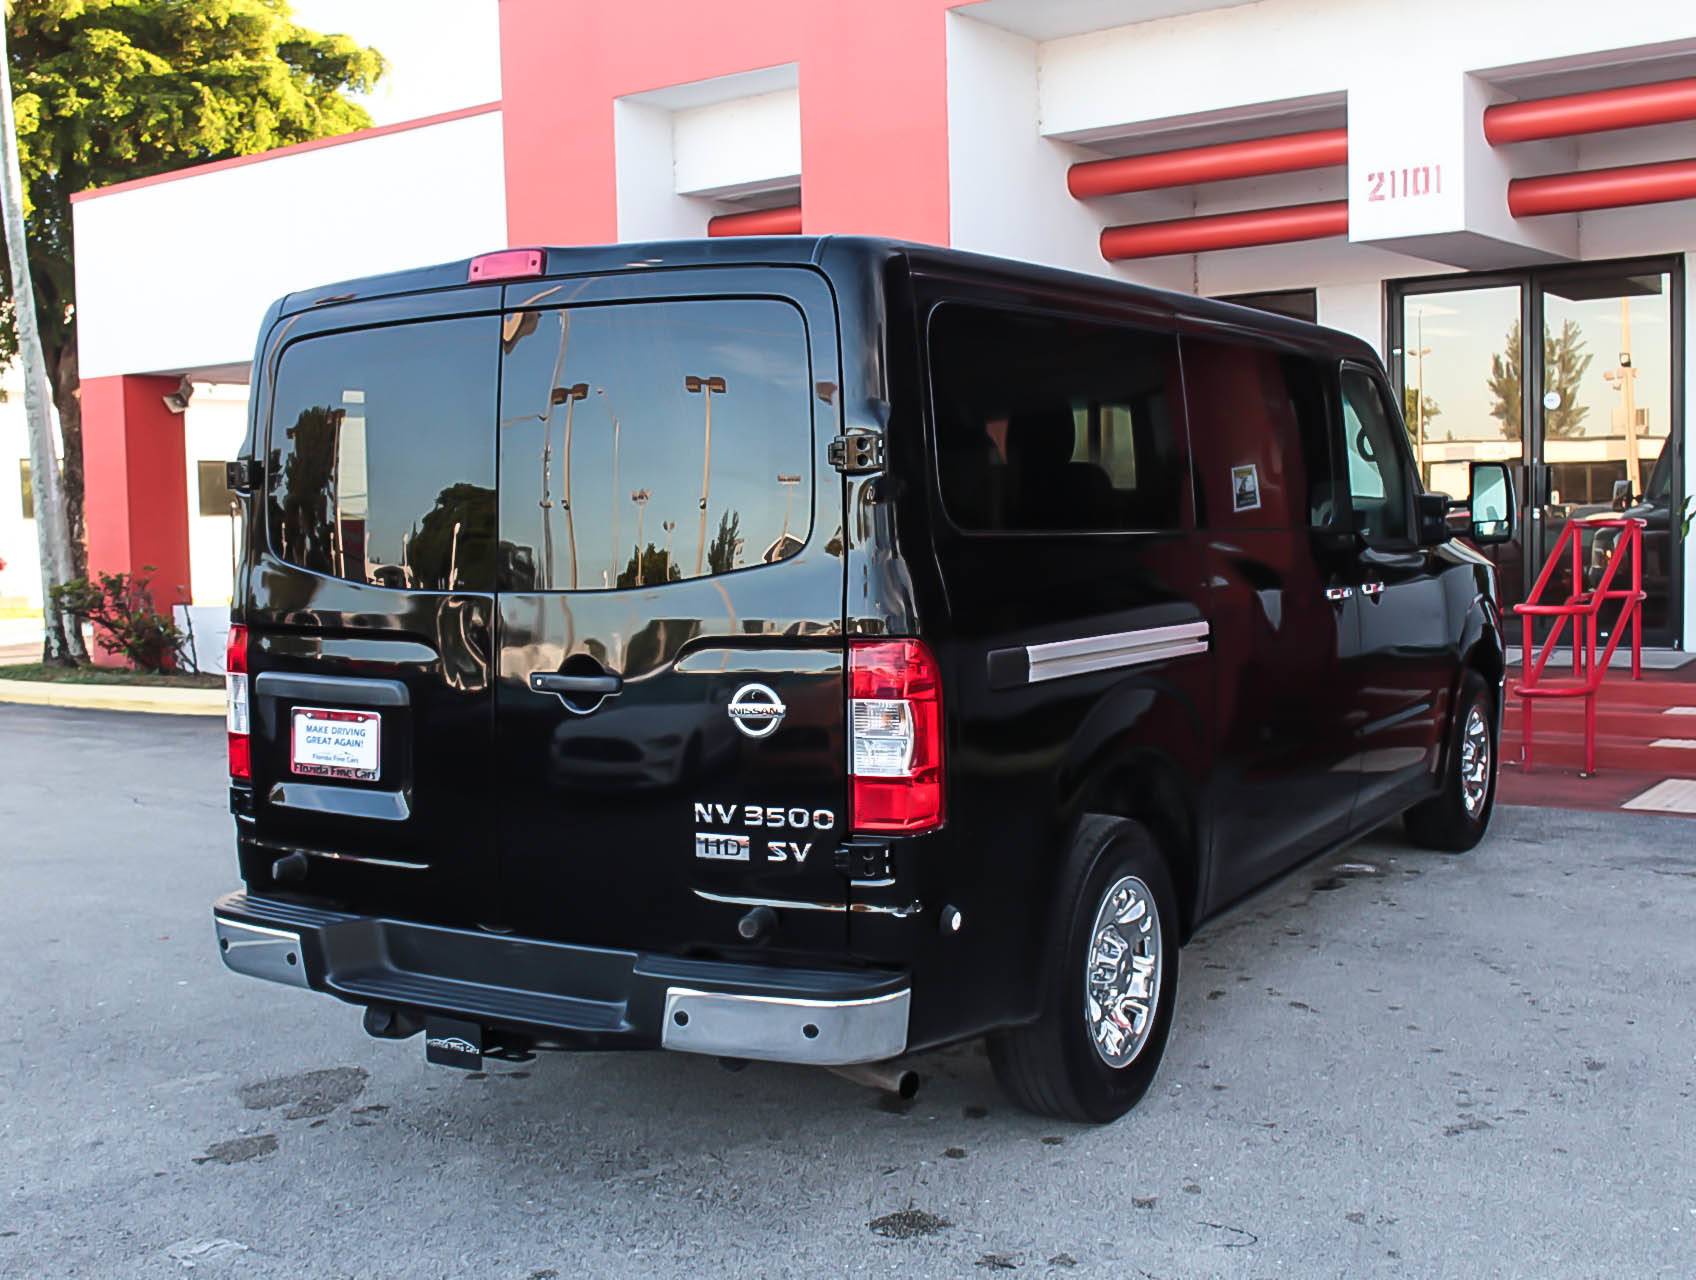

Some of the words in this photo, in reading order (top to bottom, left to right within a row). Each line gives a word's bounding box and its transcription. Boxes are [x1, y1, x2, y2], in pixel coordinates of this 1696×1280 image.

[1367, 165, 1441, 202] 21101
[732, 706, 779, 716] NISSAN
[306, 725, 329, 735] MAKE
[332, 727, 366, 738] DRIVING
[306, 735, 332, 745] GREAT
[334, 737, 364, 748] AGAIN!
[294, 763, 328, 774] Florida
[330, 766, 352, 777] Fine
[354, 768, 377, 780] Cars
[694, 802, 738, 824] NV
[744, 806, 835, 830] 3500
[704, 837, 741, 856] HD
[767, 841, 812, 862] SV
